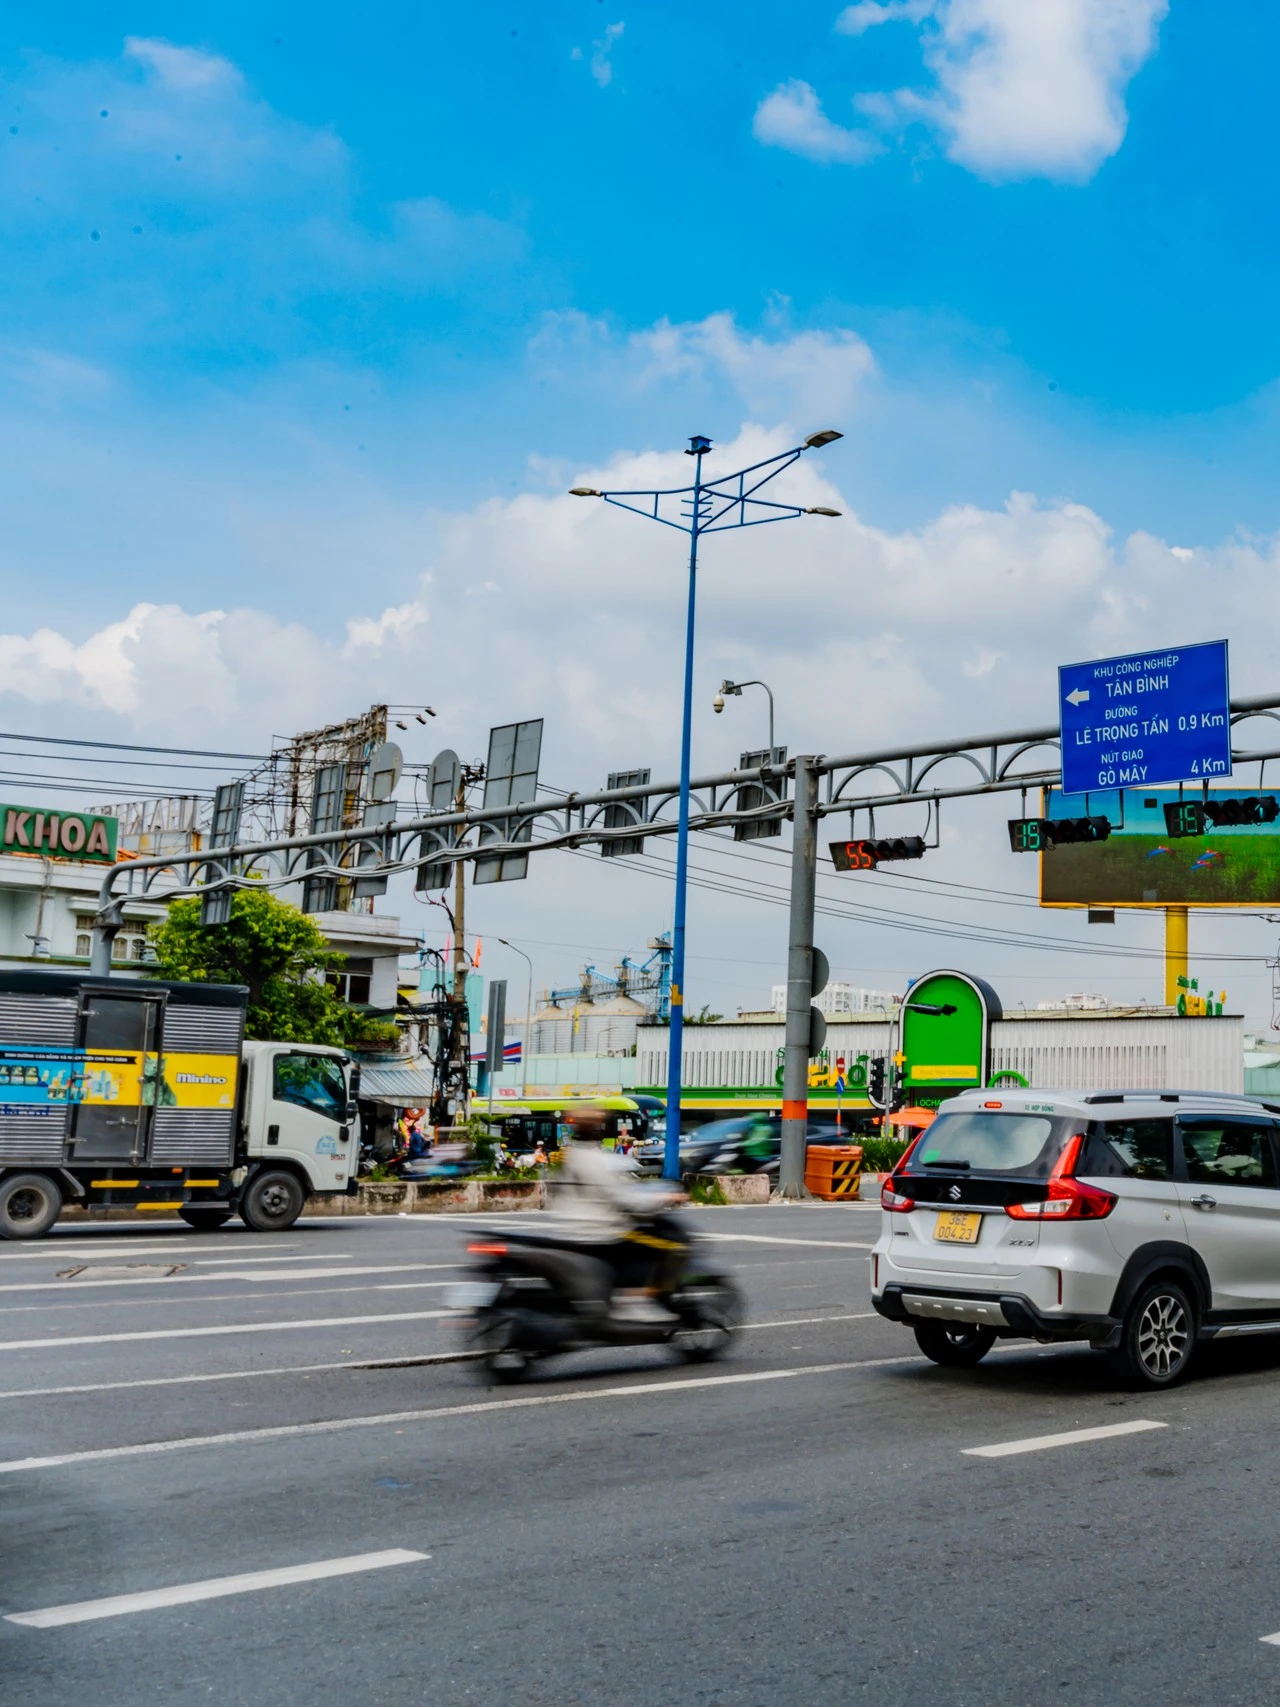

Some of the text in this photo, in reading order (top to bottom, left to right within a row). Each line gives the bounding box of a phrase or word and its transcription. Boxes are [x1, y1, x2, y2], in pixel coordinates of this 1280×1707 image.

[1094, 654, 1179, 678] KHU CÔNG NGHIỆP
[1106, 674, 1169, 698] TÂN BÌNH
[1105, 705, 1138, 720] ĐƯỜNG
[1076, 712, 1224, 745] LÊ TRỌNG TẤN 0.9 Km
[1101, 749, 1144, 764] NÚT GIAO
[1098, 758, 1225, 786] GÒ MÂY 4 Km
[1180, 804, 1198, 832] 15
[4, 810, 109, 855] KHOA
[1022, 822, 1040, 848] 15
[845, 842, 872, 869] 55
[176, 1073, 228, 1085] Minino
[949, 1212, 968, 1226] 36E
[938, 1226, 972, 1240] 004.23
